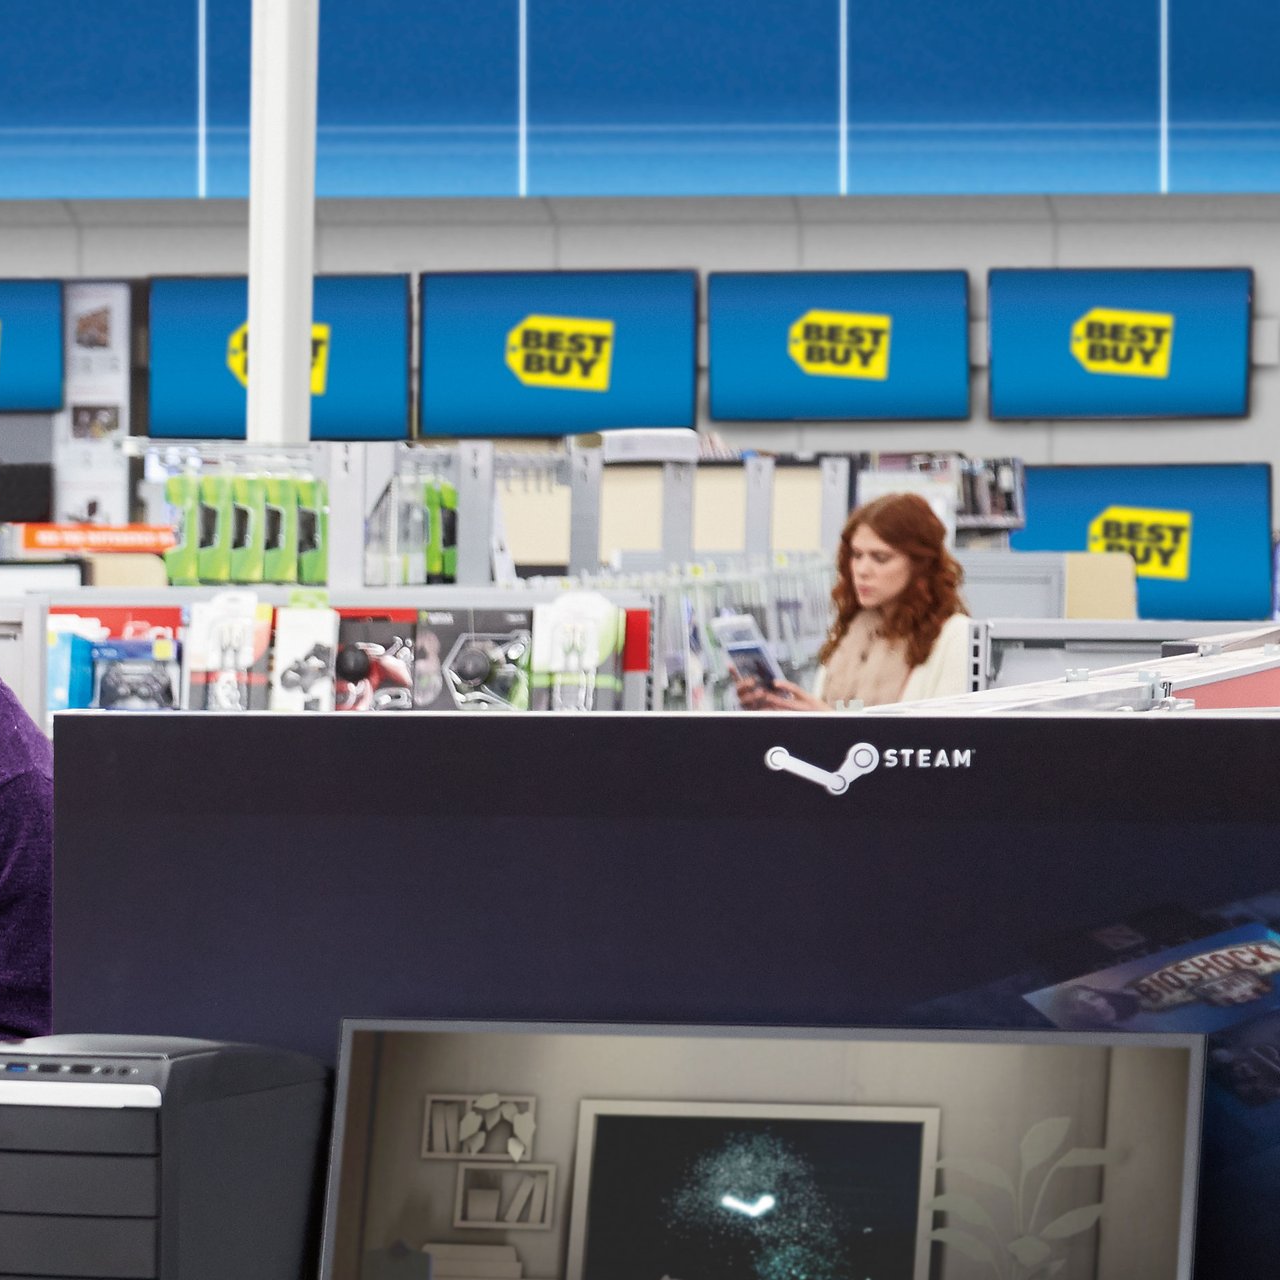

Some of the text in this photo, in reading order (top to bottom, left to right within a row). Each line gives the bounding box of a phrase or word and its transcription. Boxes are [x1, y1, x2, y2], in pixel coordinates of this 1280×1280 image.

[520, 328, 609, 356] BEST
[802, 322, 886, 349] BEST
[1084, 320, 1169, 347] BEST
[522, 350, 598, 378] BUY
[805, 344, 876, 368] BUY
[1087, 342, 1158, 366] BUY
[1101, 519, 1187, 547] BEST
[884, 748, 972, 769] STEAM
[1142, 942, 1280, 1004] BIOSHOCK
